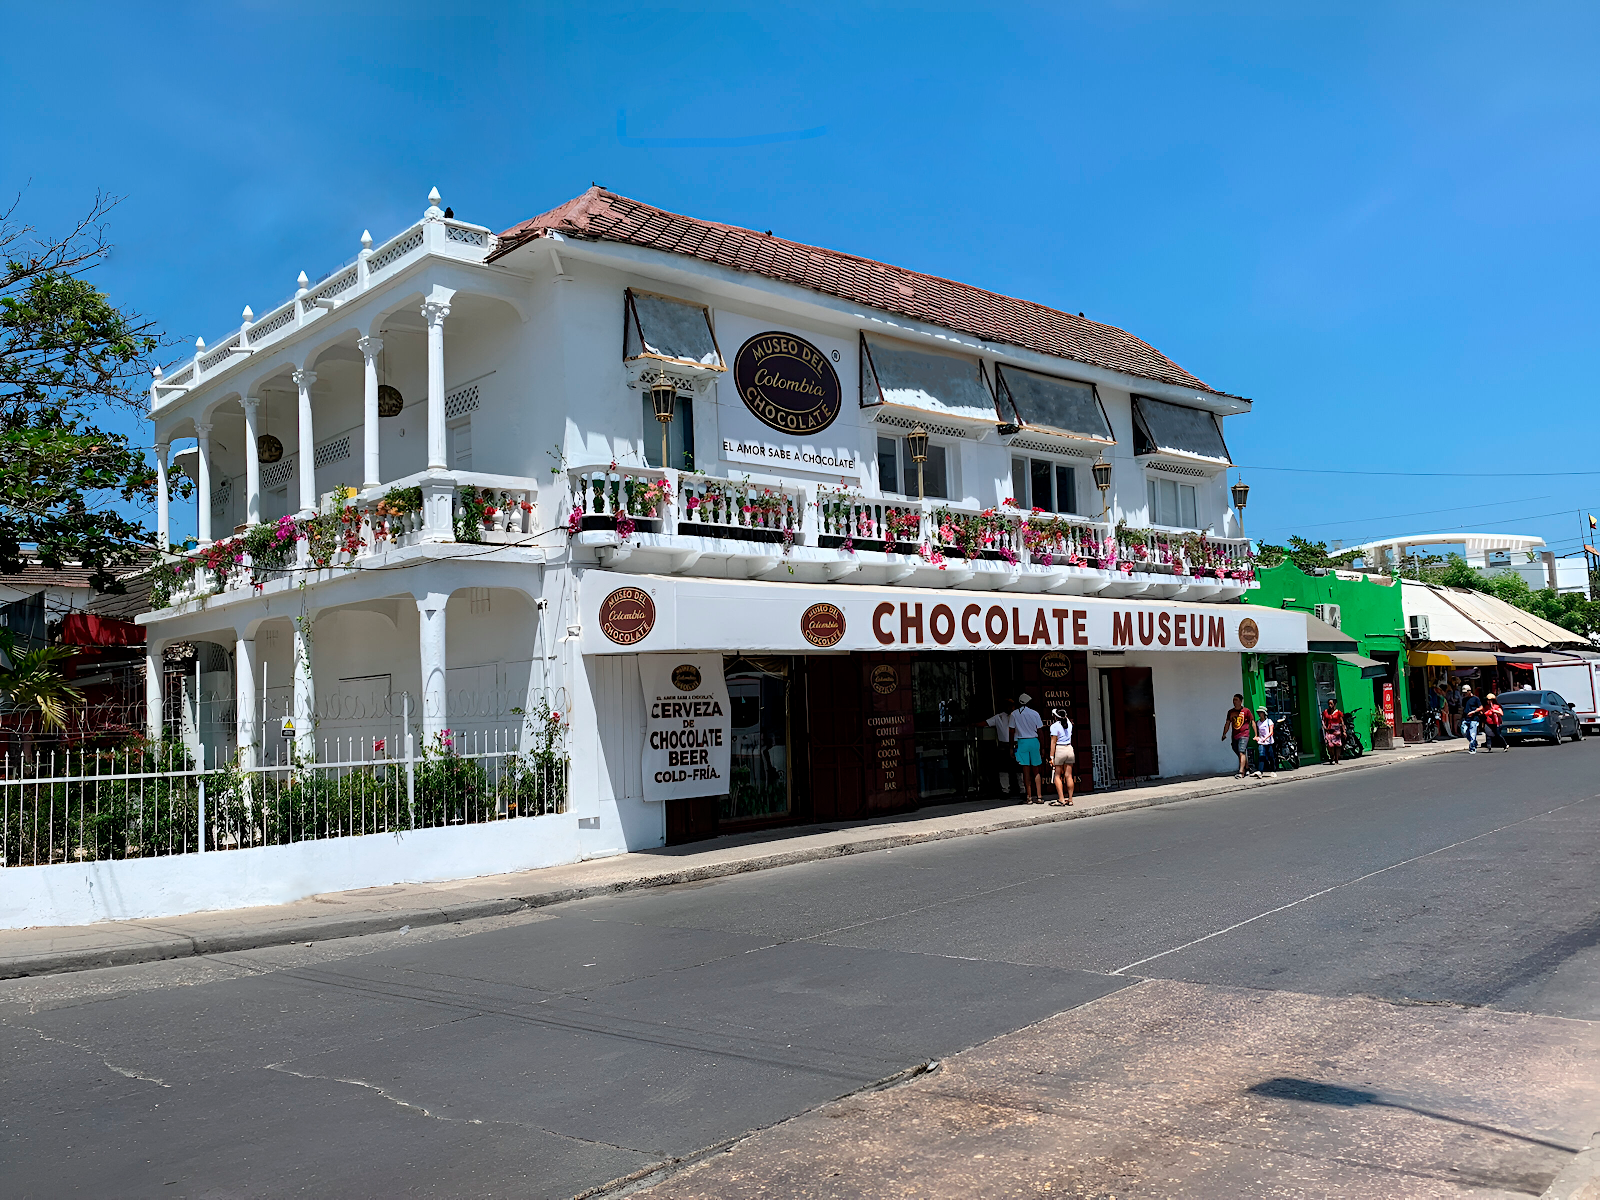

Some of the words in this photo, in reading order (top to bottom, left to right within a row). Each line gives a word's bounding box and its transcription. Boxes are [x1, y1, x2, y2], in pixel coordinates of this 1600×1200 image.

[752, 338, 799, 361] MUSEO
[801, 347, 824, 375] DEL
[754, 368, 826, 397] Colombia
[746, 386, 832, 429] CHOCOLATE
[723, 440, 734, 451] EL
[736, 443, 766, 456] AMOR
[768, 448, 792, 460] SABE
[794, 452, 801, 462] A
[802, 453, 854, 469] CHOCOLATE
[608, 590, 633, 608] MUSEO
[634, 591, 647, 606] DEL
[608, 609, 646, 621] Colombia
[872, 602, 1089, 645] CHOCOLATE
[1112, 611, 1226, 648] MUSEUM
[604, 622, 651, 642] CHOCOLATE
[651, 701, 723, 719] CERVEZA
[682, 719, 695, 729] DE
[649, 728, 723, 750] CHOCOLATE
[668, 749, 709, 767] BEER
